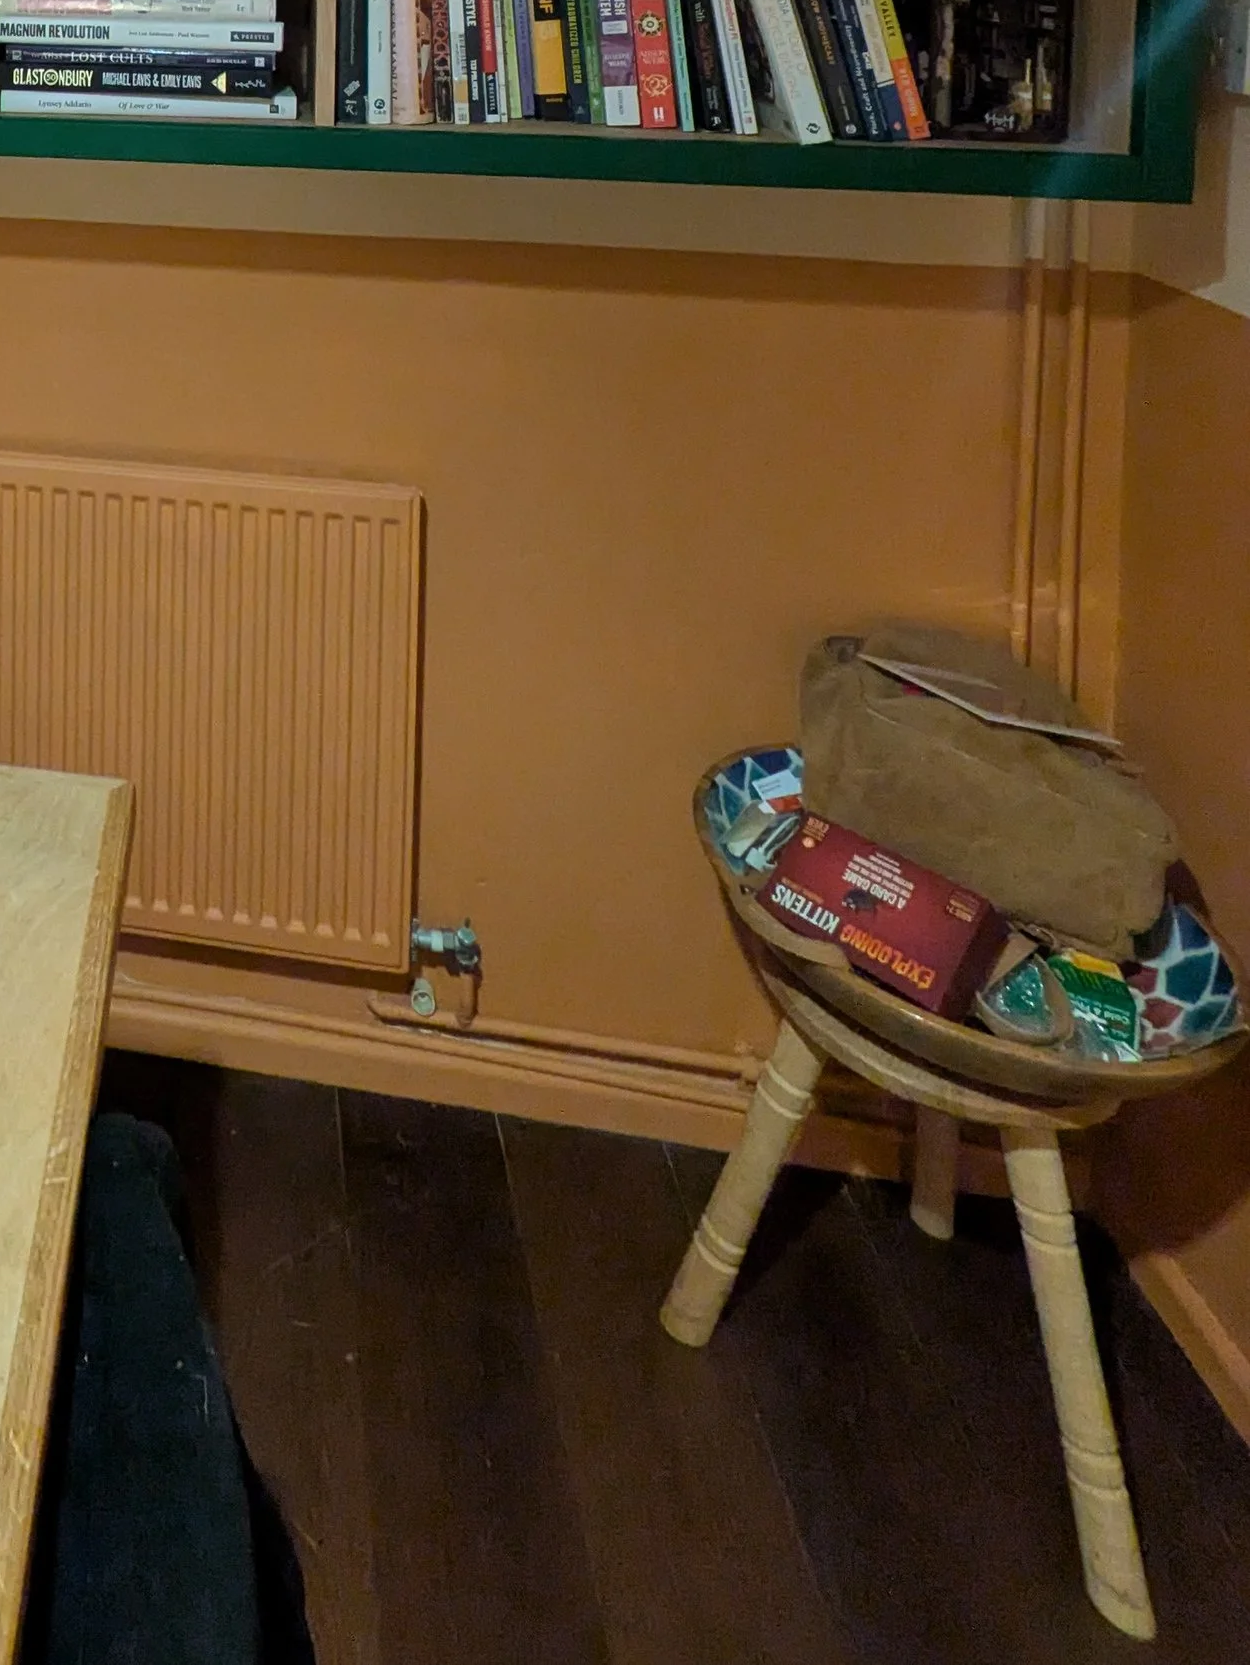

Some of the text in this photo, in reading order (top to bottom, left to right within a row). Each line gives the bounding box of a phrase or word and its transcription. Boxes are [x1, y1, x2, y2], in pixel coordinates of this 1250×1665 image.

[482, 0, 491, 28] SHOULD
[692, 1, 705, 22] with
[764, 4, 786, 48] BICYCLE
[878, 0, 896, 38] VALLEY
[1, 24, 109, 39] MAGNUM REVOLUTION
[241, 33, 271, 41] PRESTEL
[484, 29, 492, 51] KNOW
[813, 14, 836, 65] APOTHECARY
[70, 52, 153, 64] LOST CULTS
[570, 48, 581, 84] CHILDREN
[102, 72, 131, 87] MICHAEL
[133, 73, 151, 87] EAVIS
[152, 74, 159, 87] &
[161, 74, 181, 88] EMILY
[183, 75, 201, 88] EAVIS
[471, 70, 479, 101] POLHEMUS
[38, 100, 62, 109] Lynsey
[119, 102, 128, 110] Of
[488, 82, 496, 112] PRESTEL
[841, 867, 907, 909] A CARD GAME
[769, 882, 935, 989] EXPLODING KITTENS
